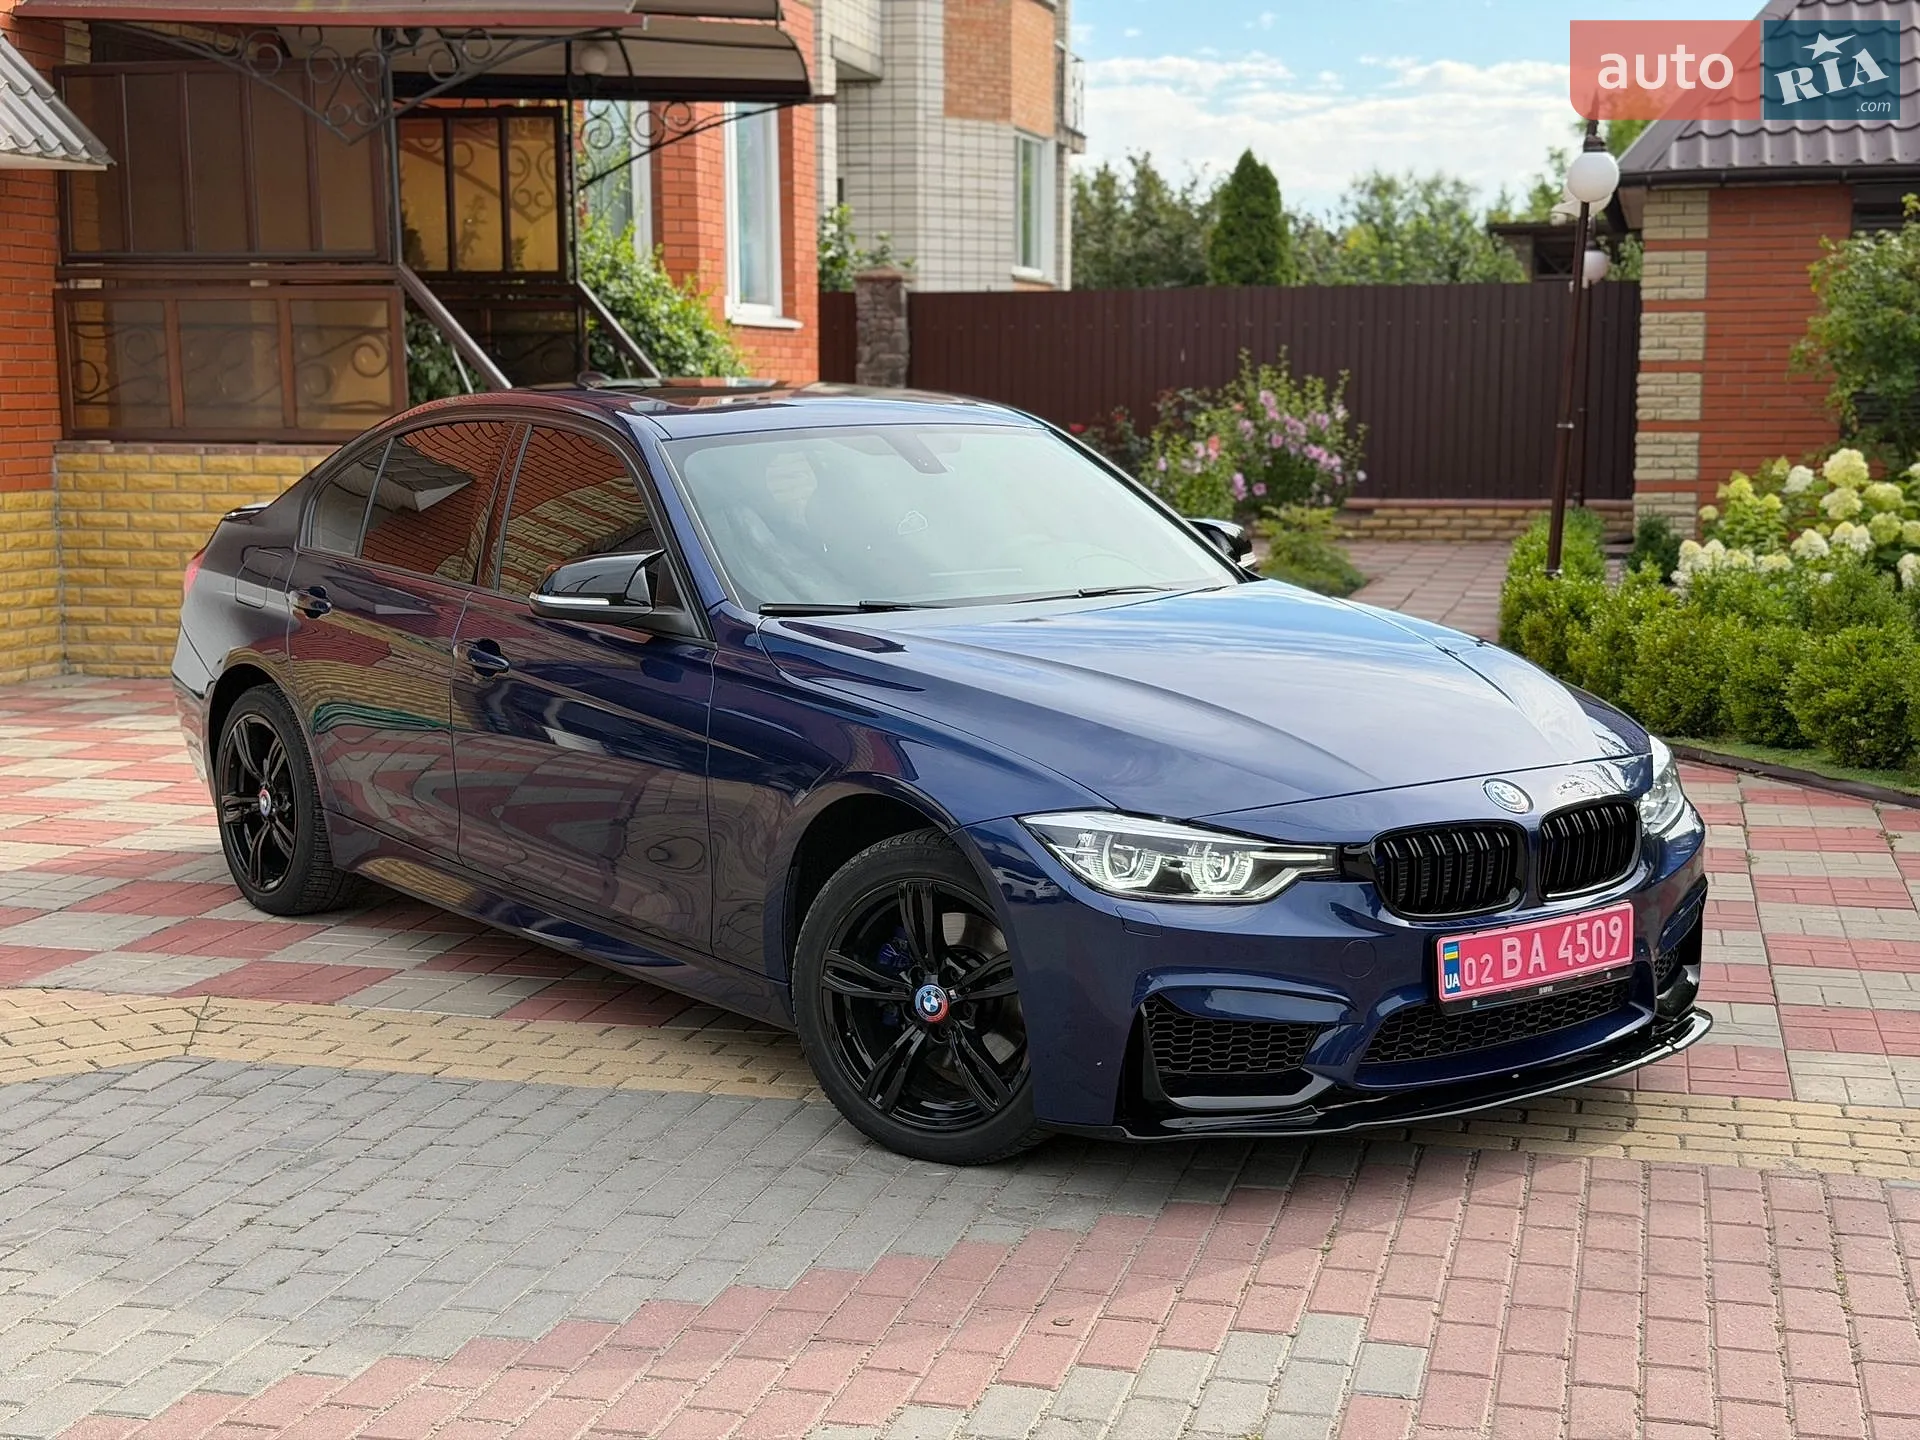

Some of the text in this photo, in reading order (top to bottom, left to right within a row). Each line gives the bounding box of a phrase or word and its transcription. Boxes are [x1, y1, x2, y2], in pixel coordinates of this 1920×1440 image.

[1464, 916, 1622, 987] 02 BA 4509
[1444, 973, 1460, 989] UA
